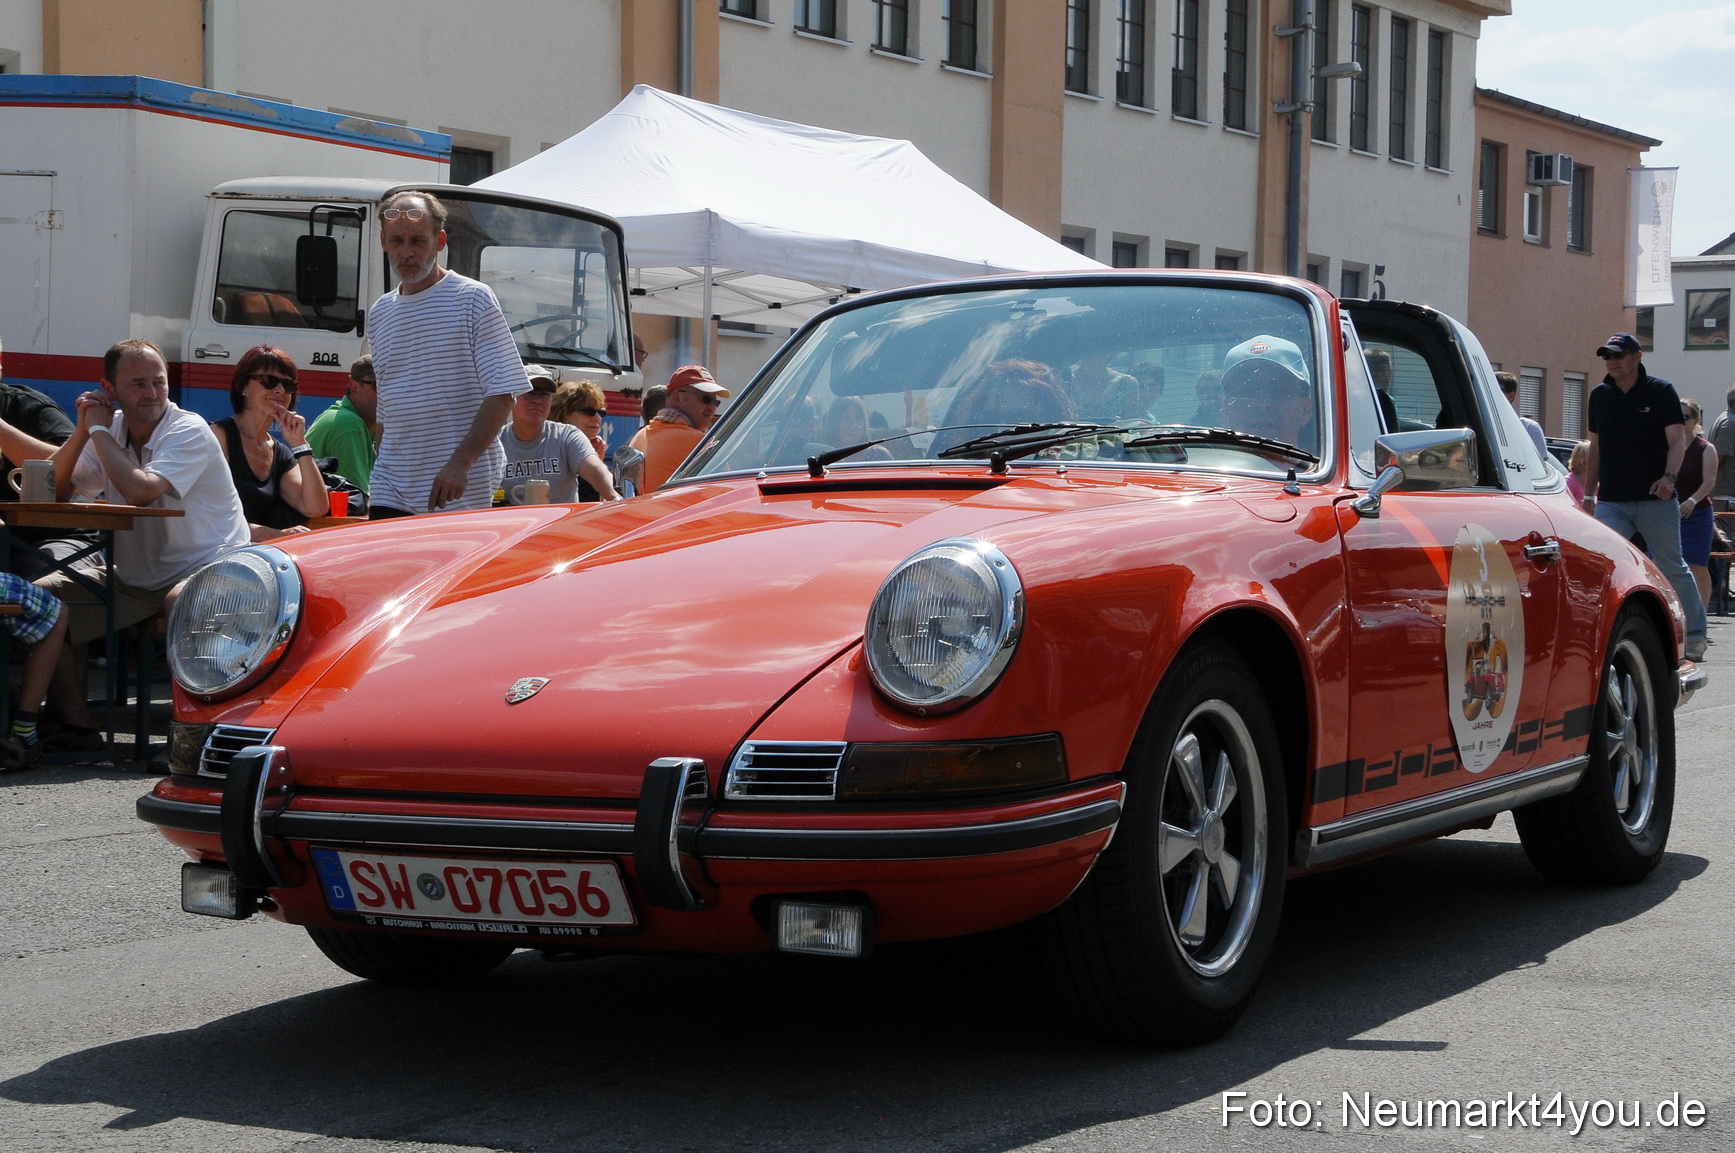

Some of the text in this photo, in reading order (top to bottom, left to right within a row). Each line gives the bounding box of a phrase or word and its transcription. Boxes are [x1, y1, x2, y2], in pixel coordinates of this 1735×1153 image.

[1651, 198, 1662, 283] OFENWERK
[1372, 264, 1386, 300] 5
[312, 352, 340, 363] 808
[504, 457, 561, 479] EATTLE
[1465, 596, 1505, 606] PORSCHE
[1481, 607, 1492, 618] 911
[1472, 721, 1494, 730] JAHRE
[332, 885, 345, 899] D
[350, 859, 611, 917] SW 07056
[383, 918, 423, 928] AUTOHAUS
[430, 921, 477, 931] KAROSSERIE
[478, 923, 528, 933] OSWALD
